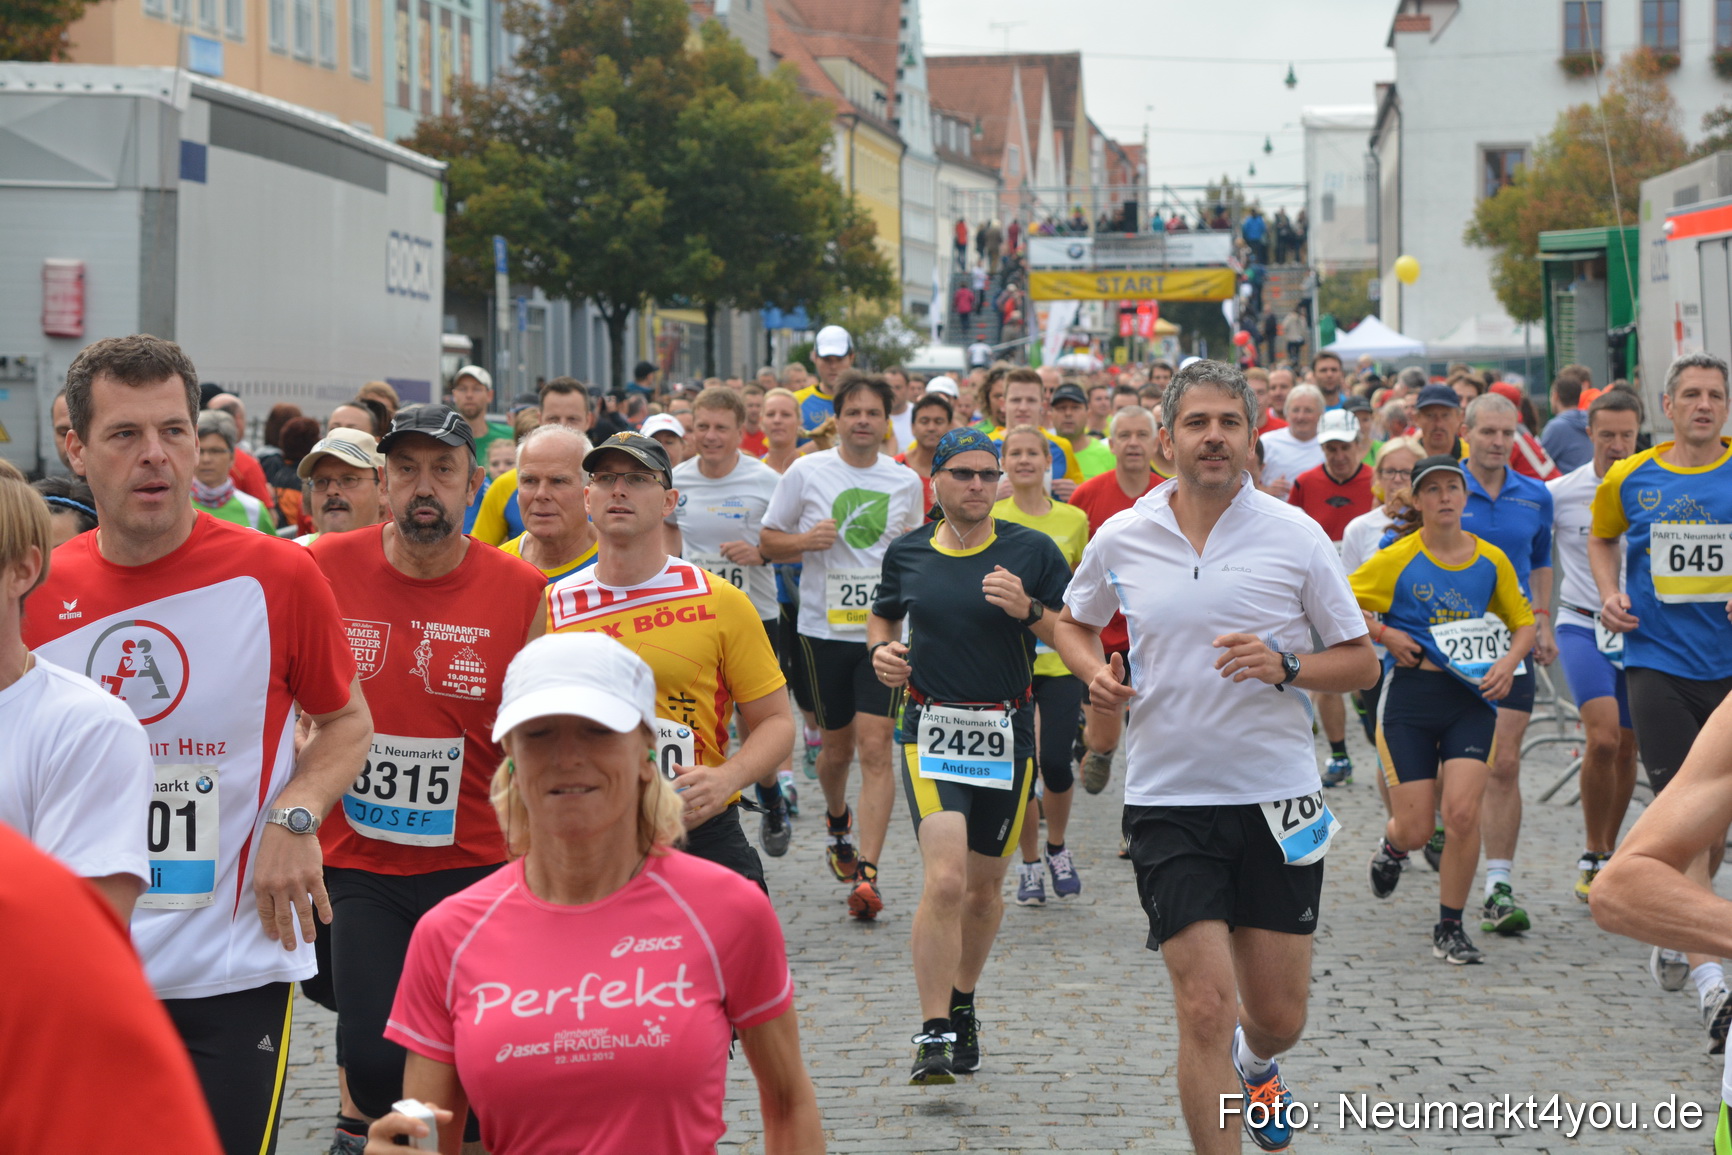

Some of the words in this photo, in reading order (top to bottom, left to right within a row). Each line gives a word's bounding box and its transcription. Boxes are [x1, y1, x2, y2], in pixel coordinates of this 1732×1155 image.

[1095, 275, 1168, 294] START
[1652, 530, 1681, 540] PARTL
[1684, 532, 1726, 540] Neumarkt
[1668, 544, 1724, 572] 645
[59, 610, 82, 620] erima
[633, 604, 716, 634] BÖGL
[345, 627, 380, 639] MMER
[411, 620, 424, 630] 11.
[425, 622, 491, 638] NEUMARKTER
[423, 630, 478, 644] STADTLAUF
[348, 637, 381, 649] IEDER
[1445, 635, 1498, 661] 2379
[350, 647, 377, 662] EU
[447, 673, 487, 684] 19.09.2010
[922, 712, 951, 724] PARTL
[953, 717, 997, 728] Neumarkt
[928, 727, 1005, 758] 2429
[385, 745, 443, 759] Neumarkt
[941, 761, 990, 776] Andreas
[355, 802, 433, 827] JOSEF
[632, 935, 683, 953] asics
[469, 963, 696, 1025] Perfekt
[553, 1033, 671, 1054] FRAUENLAUF
[555, 1055, 568, 1065] 22.
[570, 1054, 591, 1064] JULI
[592, 1051, 615, 1062] 2012
